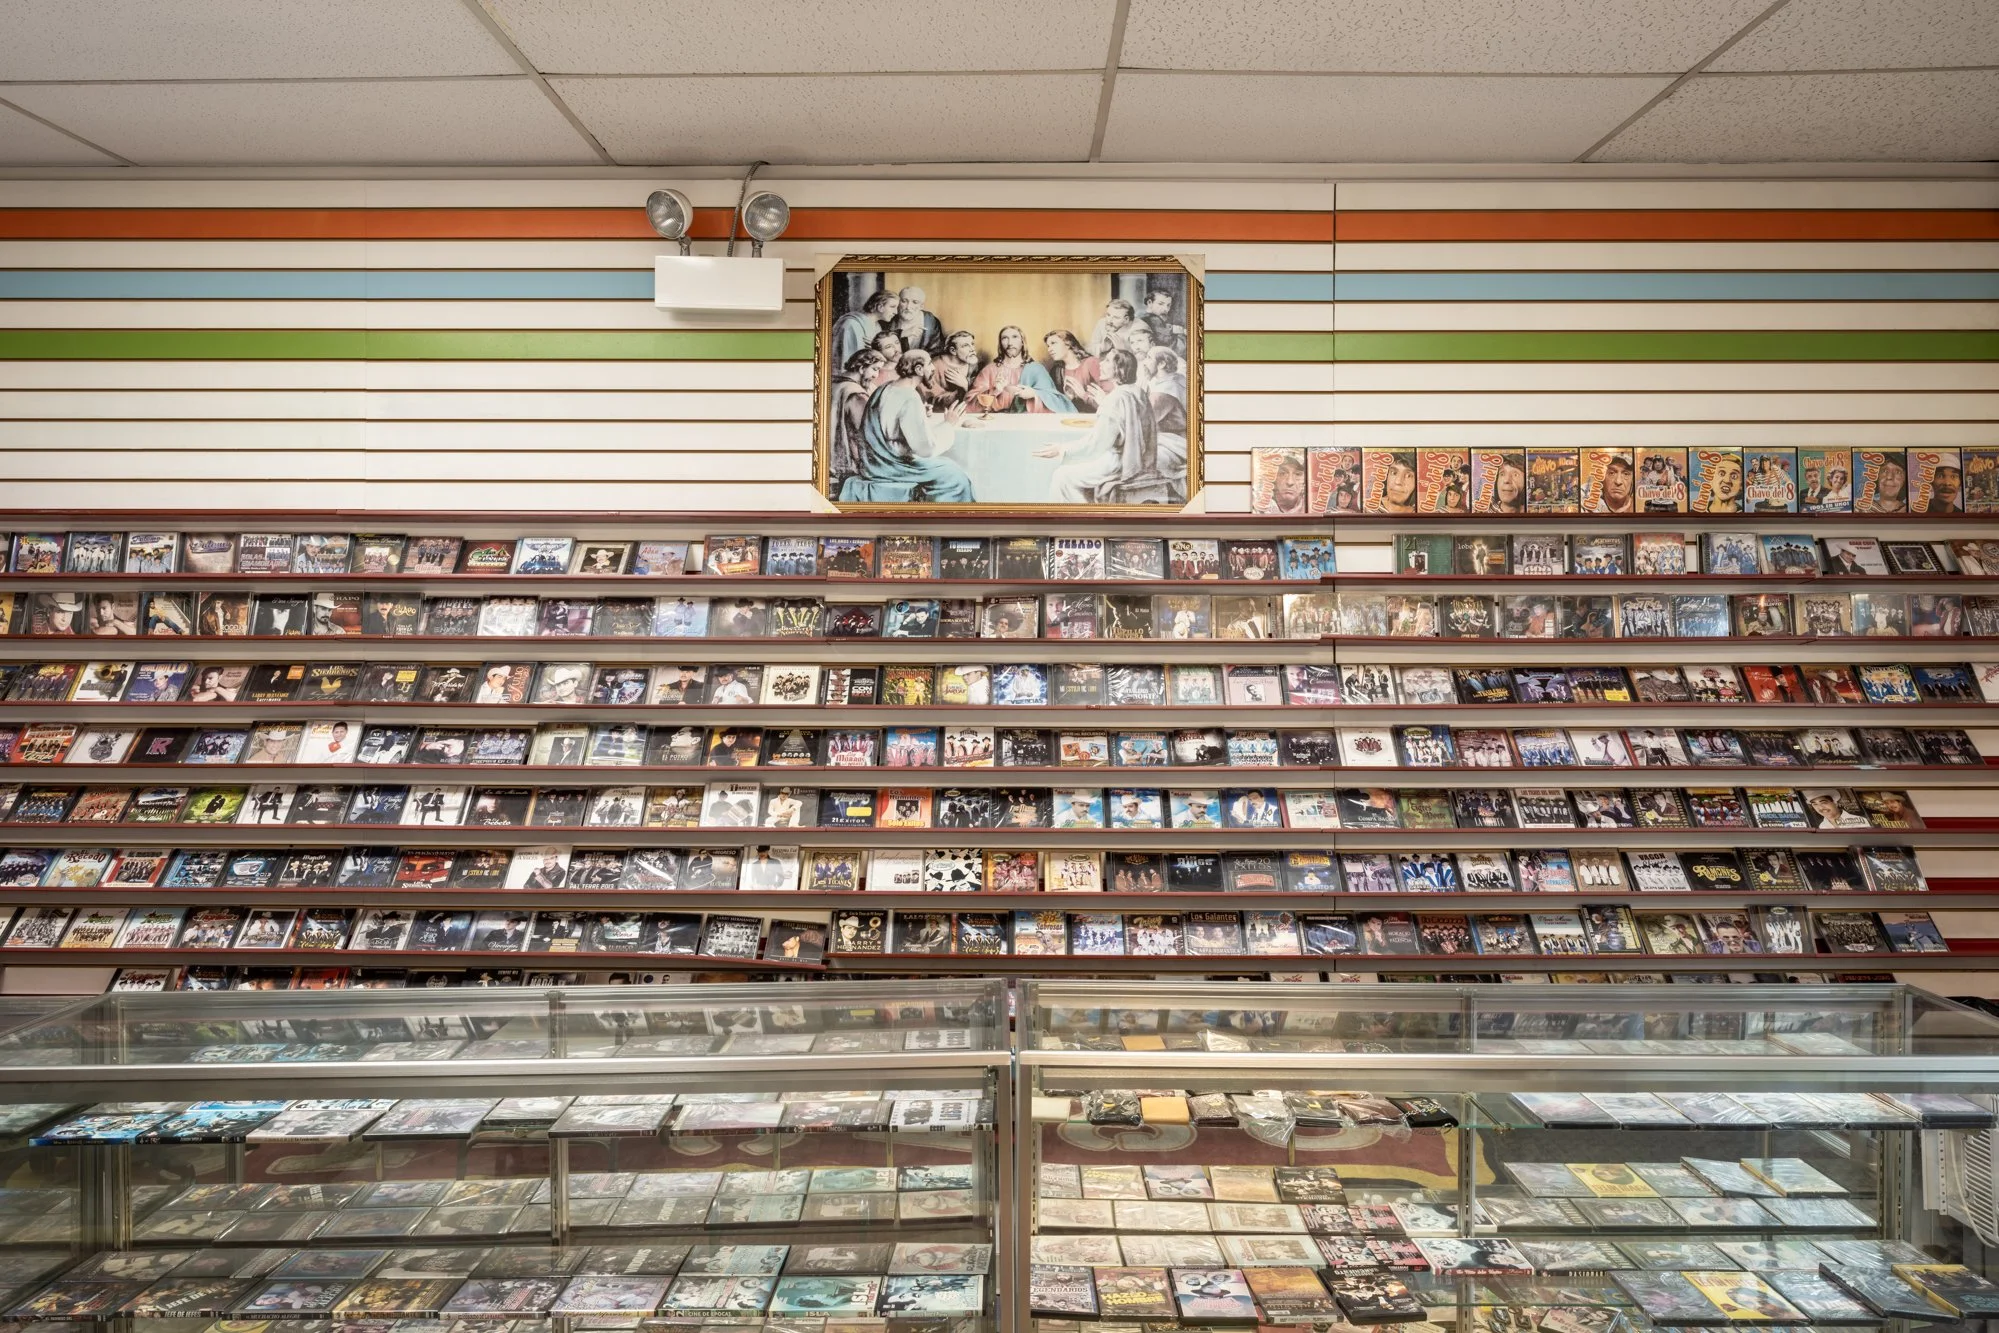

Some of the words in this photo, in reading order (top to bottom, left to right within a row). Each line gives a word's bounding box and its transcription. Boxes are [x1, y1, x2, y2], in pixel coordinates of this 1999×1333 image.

[1316, 452, 1341, 465] 8
[1371, 452, 1394, 466] 8
[1425, 452, 1450, 465] 8
[1481, 453, 1503, 466] 8
[1590, 452, 1612, 465] 8
[1699, 451, 1723, 466] 8
[1803, 456, 1824, 468] Chavo
[1824, 455, 1836, 468] del
[1836, 452, 1844, 467] 8
[1861, 452, 1885, 465] 8
[1916, 452, 1940, 465] 8
[1322, 466, 1338, 486] del
[1376, 463, 1390, 483] del
[1431, 464, 1446, 484] del
[1485, 464, 1499, 483] del
[1594, 463, 1608, 482] del
[1704, 464, 1717, 484] del
[1866, 463, 1880, 482] del
[1921, 464, 1936, 484] del
[1311, 484, 1331, 512] Chavo
[1365, 481, 1384, 511] Chavo
[1420, 483, 1440, 512] Chavo
[1474, 481, 1493, 511] Chavo
[1583, 481, 1603, 511] Chavo
[1638, 486, 1662, 499] Chavo
[1662, 487, 1675, 499] del
[1676, 482, 1685, 501] 8
[1692, 482, 1712, 512] Chavo
[1747, 486, 1772, 499] Chavo
[1772, 487, 1785, 499] del
[1786, 482, 1795, 501] 8
[1855, 480, 1875, 511] Chavo
[1911, 481, 1931, 512] Chavo
[1058, 540, 1102, 550] PESADO
[1692, 865, 1741, 881] RAMONES
[1035, 922, 1064, 931] Sabrosas
[1191, 912, 1204, 921] Los
[1205, 912, 1238, 922] Galantes
[165, 1296, 191, 1310] JEFE
[190, 1290, 207, 1301] DE
[851, 1282, 870, 1306] ISLA
